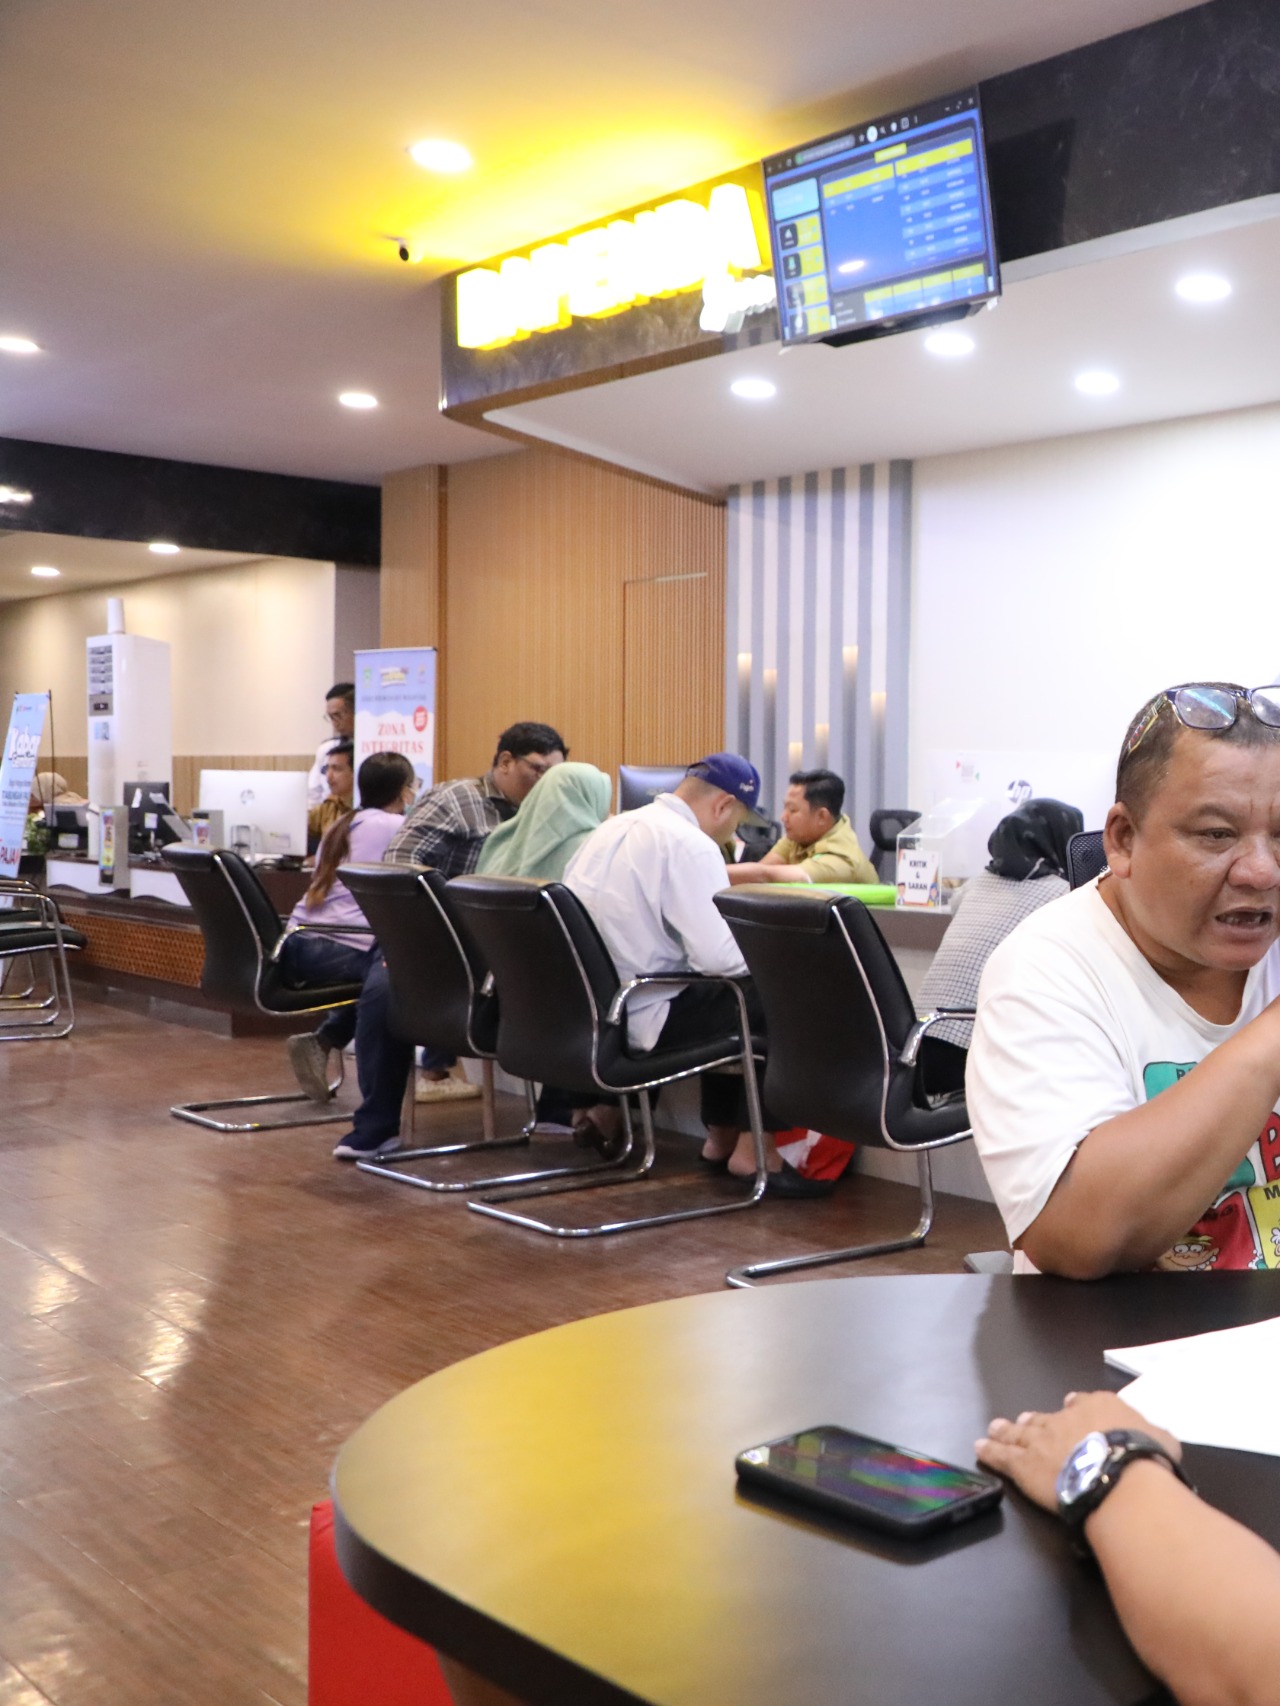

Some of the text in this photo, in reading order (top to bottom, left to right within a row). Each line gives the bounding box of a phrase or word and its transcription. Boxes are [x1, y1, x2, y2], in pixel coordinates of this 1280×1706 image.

[377, 723, 406, 736] ZONA
[909, 860, 927, 868] KRITIK
[908, 882, 928, 890] SARAN
